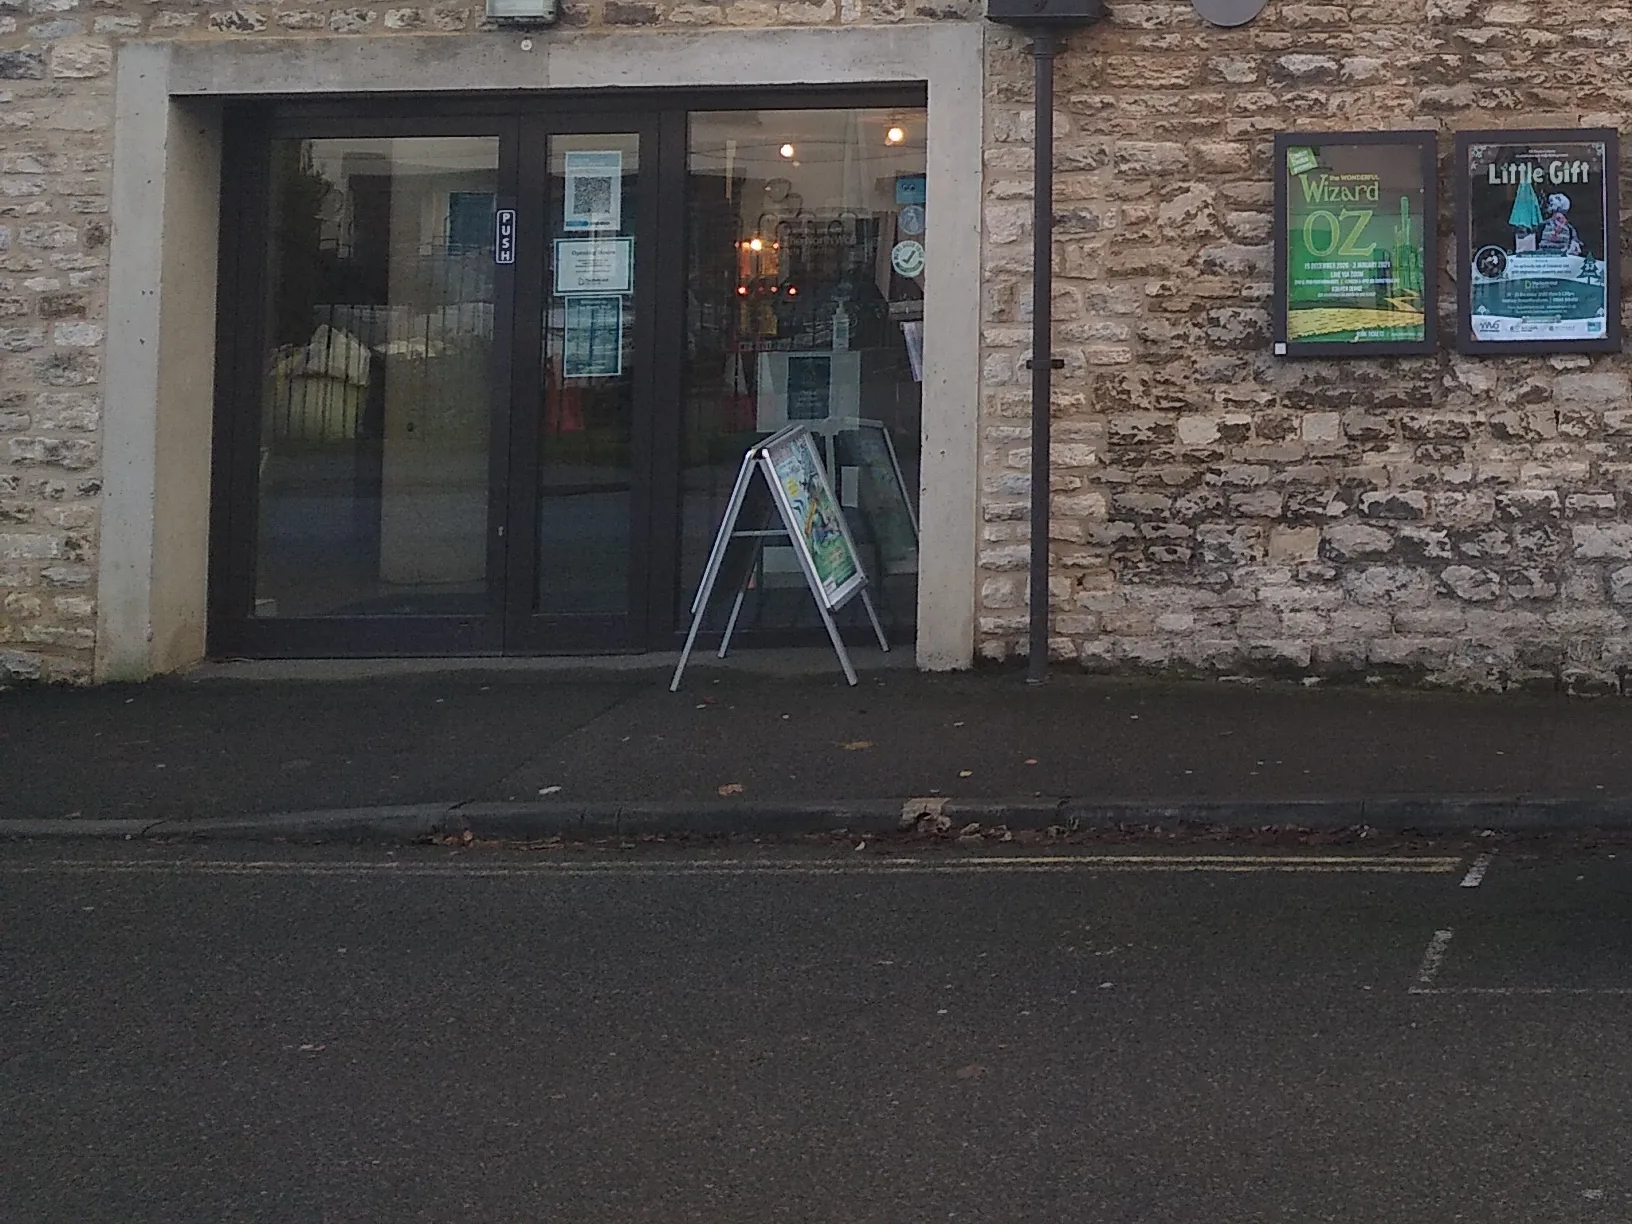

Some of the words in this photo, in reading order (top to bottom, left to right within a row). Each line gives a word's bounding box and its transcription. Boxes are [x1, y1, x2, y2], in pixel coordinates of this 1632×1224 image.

[1298, 173, 1380, 203] Wizard
[1488, 161, 1544, 184] Little
[1549, 160, 1590, 185] Gift
[500, 212, 511, 261] PUSH
[1303, 208, 1377, 256] OZ
